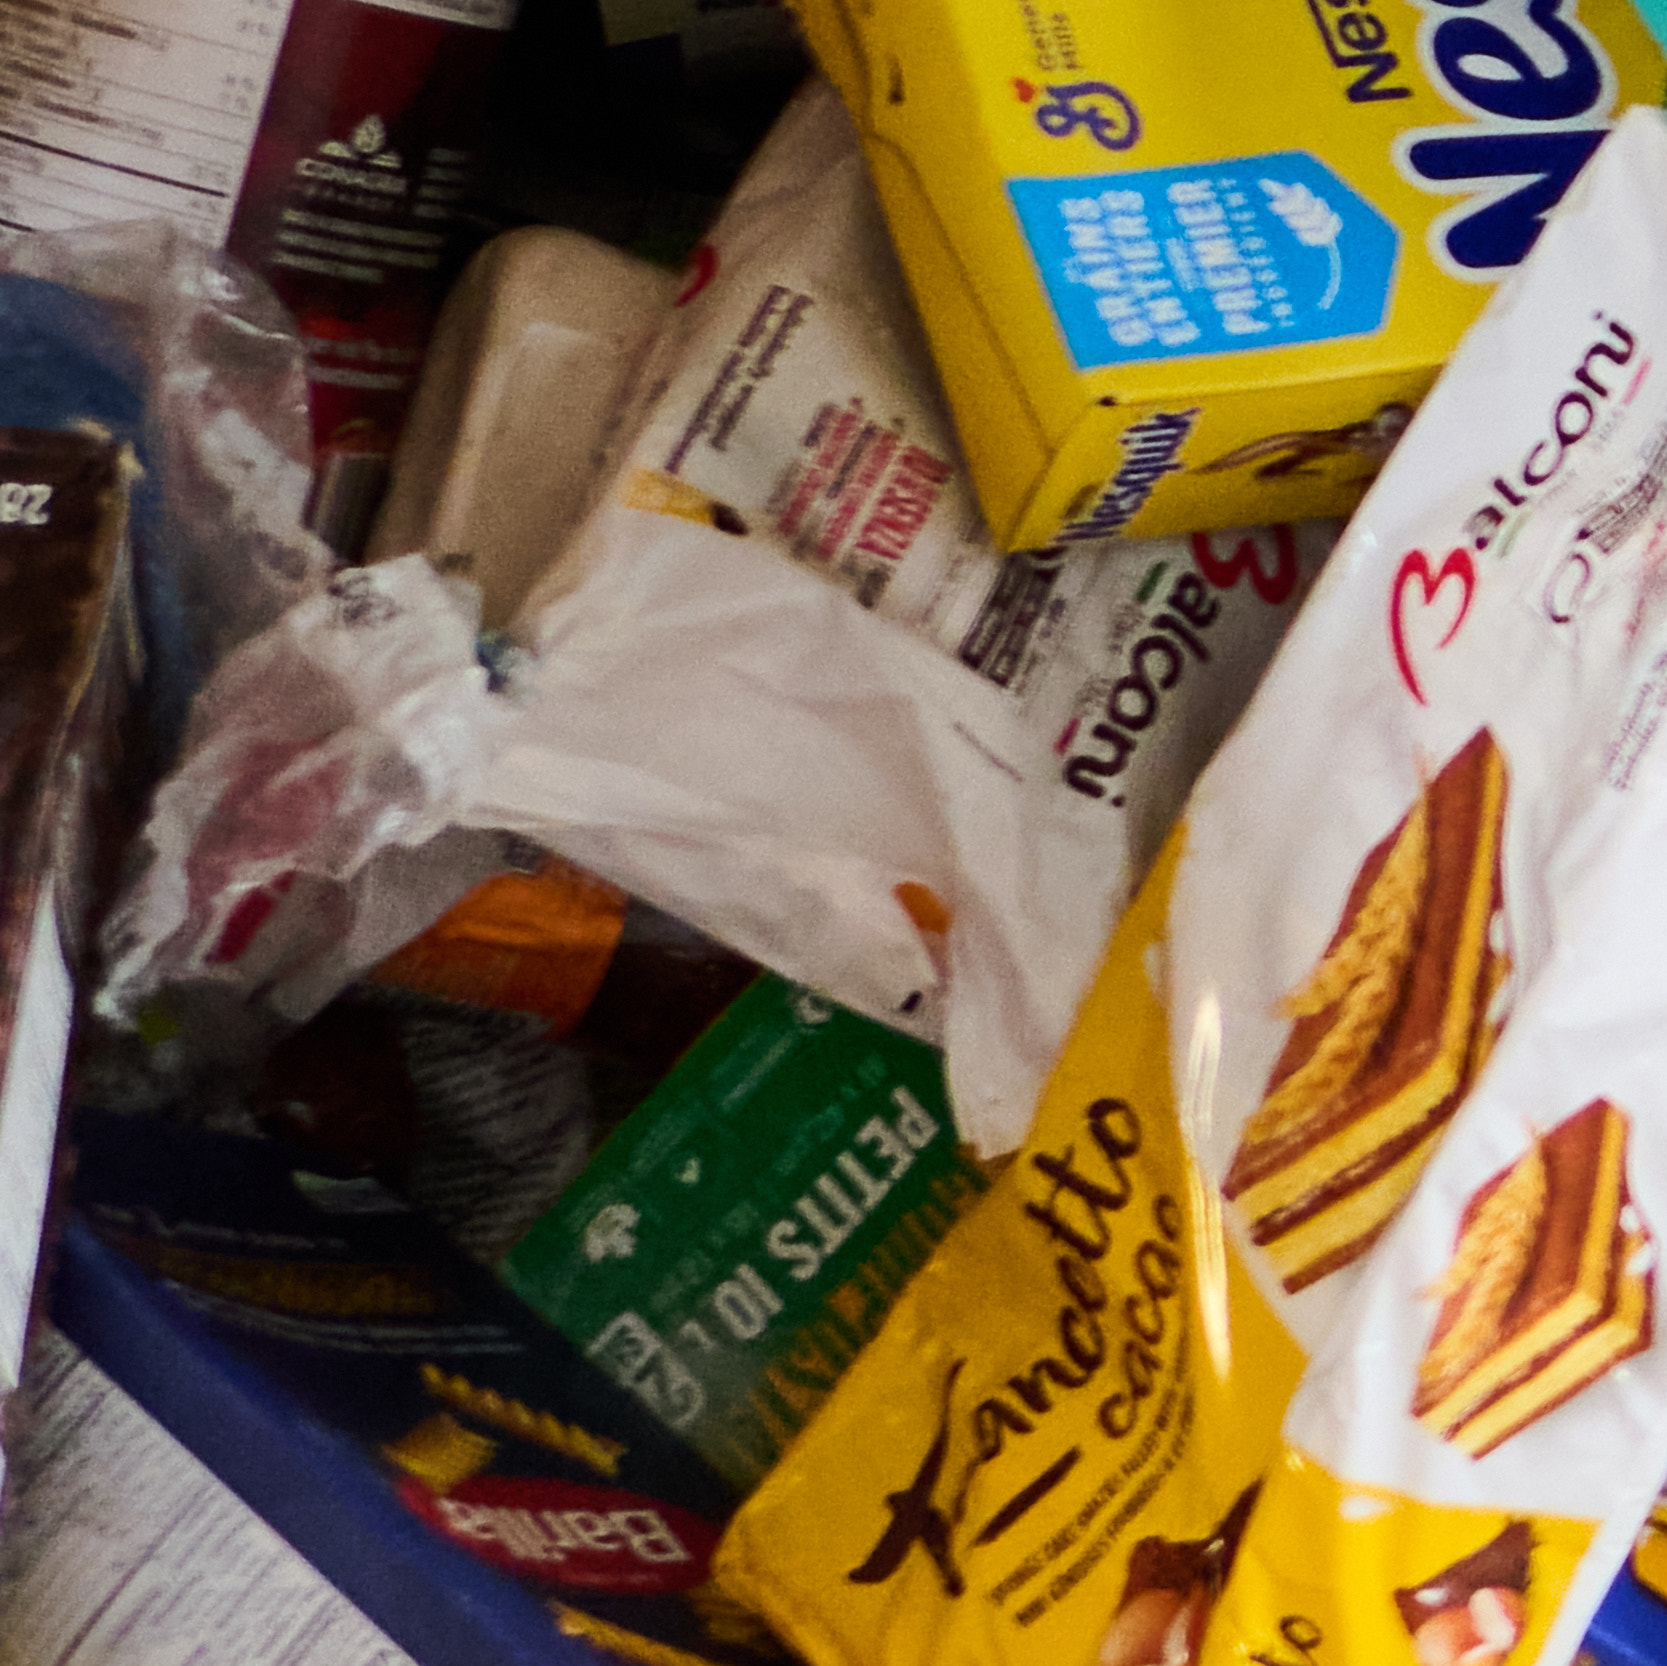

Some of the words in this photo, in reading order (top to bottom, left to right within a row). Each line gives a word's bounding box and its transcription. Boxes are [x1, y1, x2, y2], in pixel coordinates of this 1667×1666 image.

[1389, 310, 1636, 708] Balconi
[1062, 524, 1293, 805] Balconi
[756, 1083, 945, 1287] PETITS
[677, 1317, 718, 1356] L
[702, 1258, 788, 1346] 10
[844, 1102, 1142, 1597] Trancetto
[1088, 1193, 1190, 1444] cacao
[434, 1496, 689, 1563] Barilla
